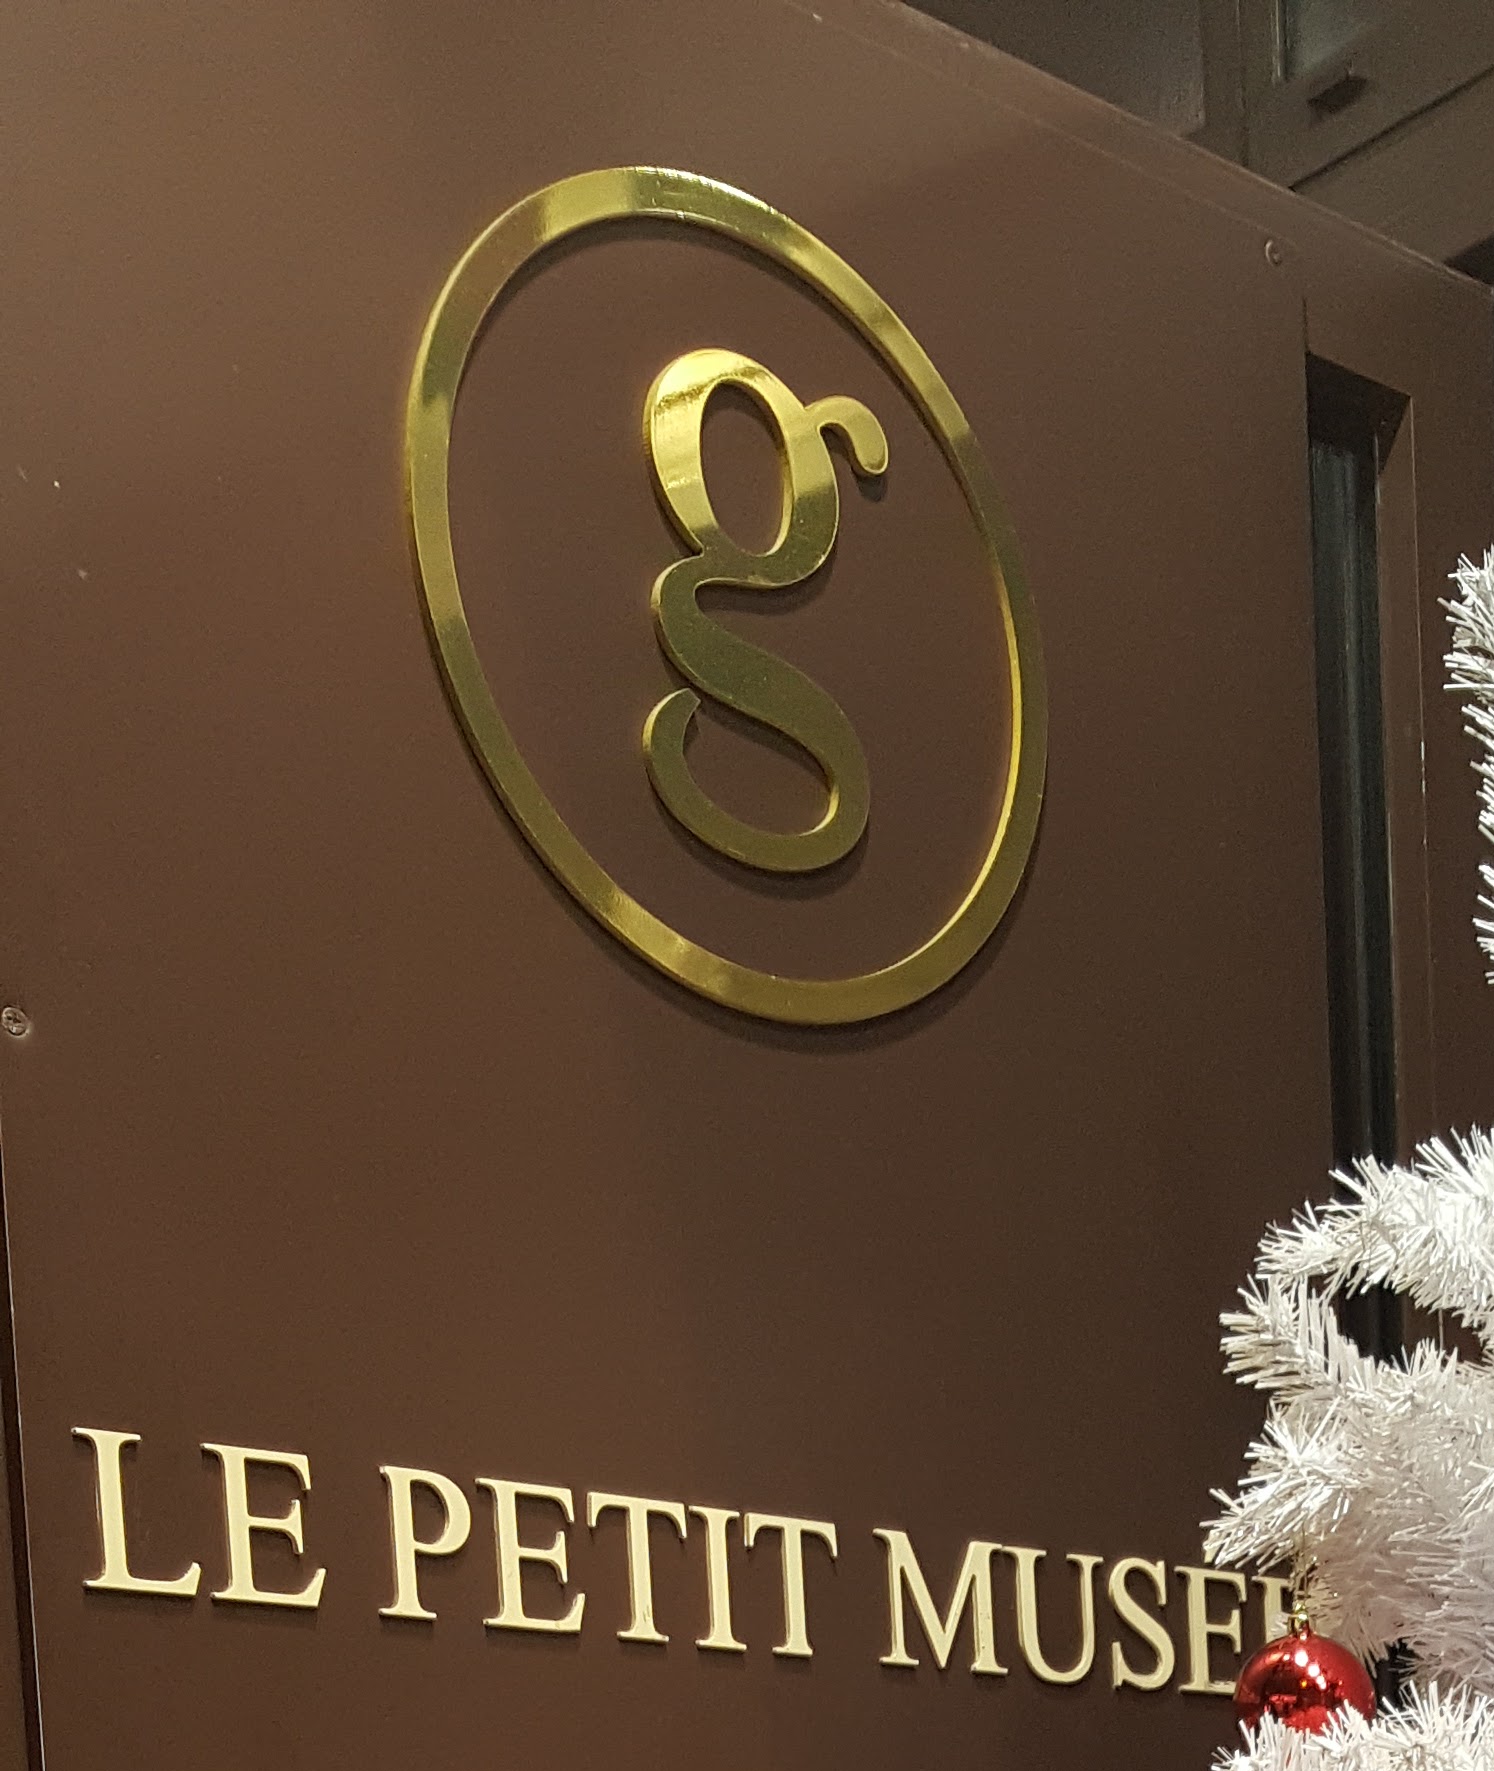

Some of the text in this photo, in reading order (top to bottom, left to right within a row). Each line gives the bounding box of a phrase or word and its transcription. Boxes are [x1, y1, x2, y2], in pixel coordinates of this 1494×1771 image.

[643, 348, 889, 871] g
[71, 1427, 327, 1608] LE
[379, 1464, 839, 1658] PETIT
